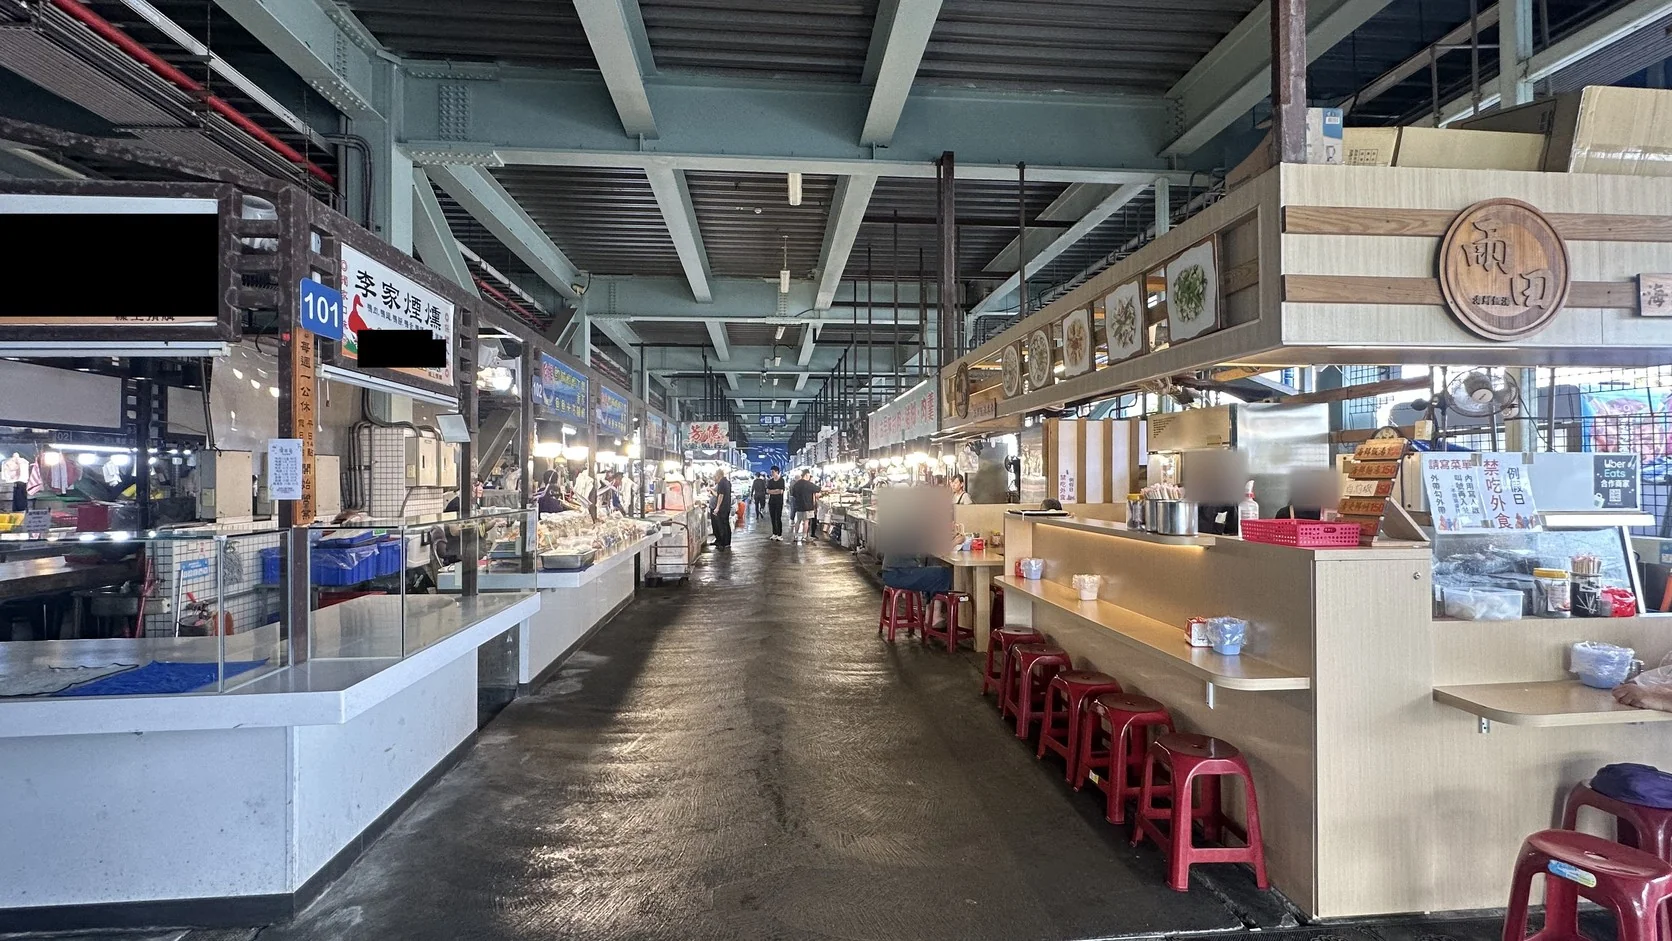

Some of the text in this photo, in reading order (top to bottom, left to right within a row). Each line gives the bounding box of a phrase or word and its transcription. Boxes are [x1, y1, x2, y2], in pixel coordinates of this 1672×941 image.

[355, 270, 441, 331] 李家煙燻
[1647, 283, 1672, 308] 海
[304, 293, 339, 328] 101
[300, 341, 311, 412] 每週一公休
[533, 382, 543, 398] 102
[1428, 459, 1473, 470] 請寫菜單
[1604, 459, 1626, 468] Uber
[1604, 469, 1626, 478] Eats
[1484, 459, 1514, 529] 禁吃外食
[1507, 467, 1525, 505] 例假日
[1600, 480, 1630, 488] 合作商家
